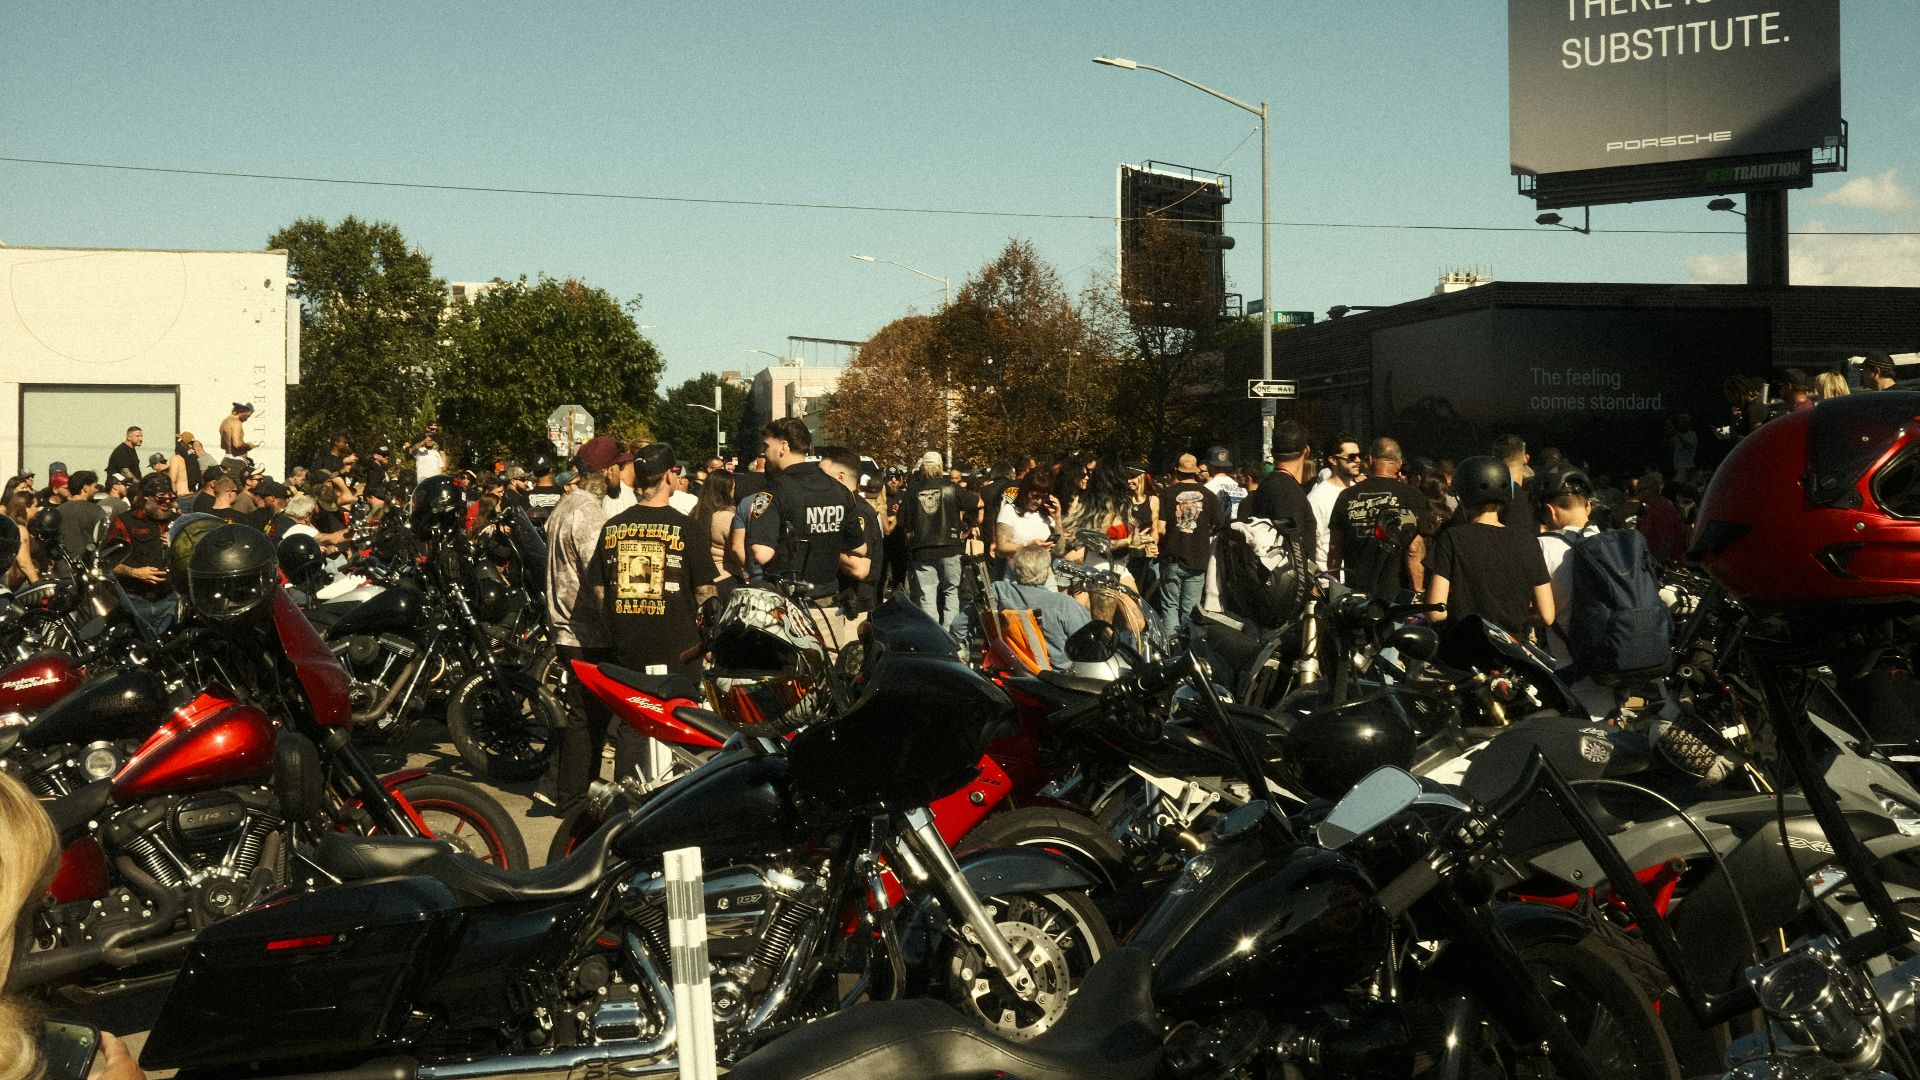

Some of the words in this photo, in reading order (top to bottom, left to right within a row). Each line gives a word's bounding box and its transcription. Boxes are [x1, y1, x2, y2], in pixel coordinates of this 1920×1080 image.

[1568, 0, 1672, 21] THE
[1562, 11, 1790, 69] SUBSTITUTE.
[1606, 130, 1732, 152] PORSCHE
[1734, 161, 1802, 181] TRADITION
[1531, 367, 1561, 386] The
[1566, 368, 1622, 391] feeling
[1530, 395, 1586, 410] comes
[1590, 393, 1666, 411] standard.
[806, 505, 845, 525] NYPD
[810, 521, 841, 534] POLICE
[620, 543, 638, 552] BIKE
[615, 599, 666, 615] SALOON
